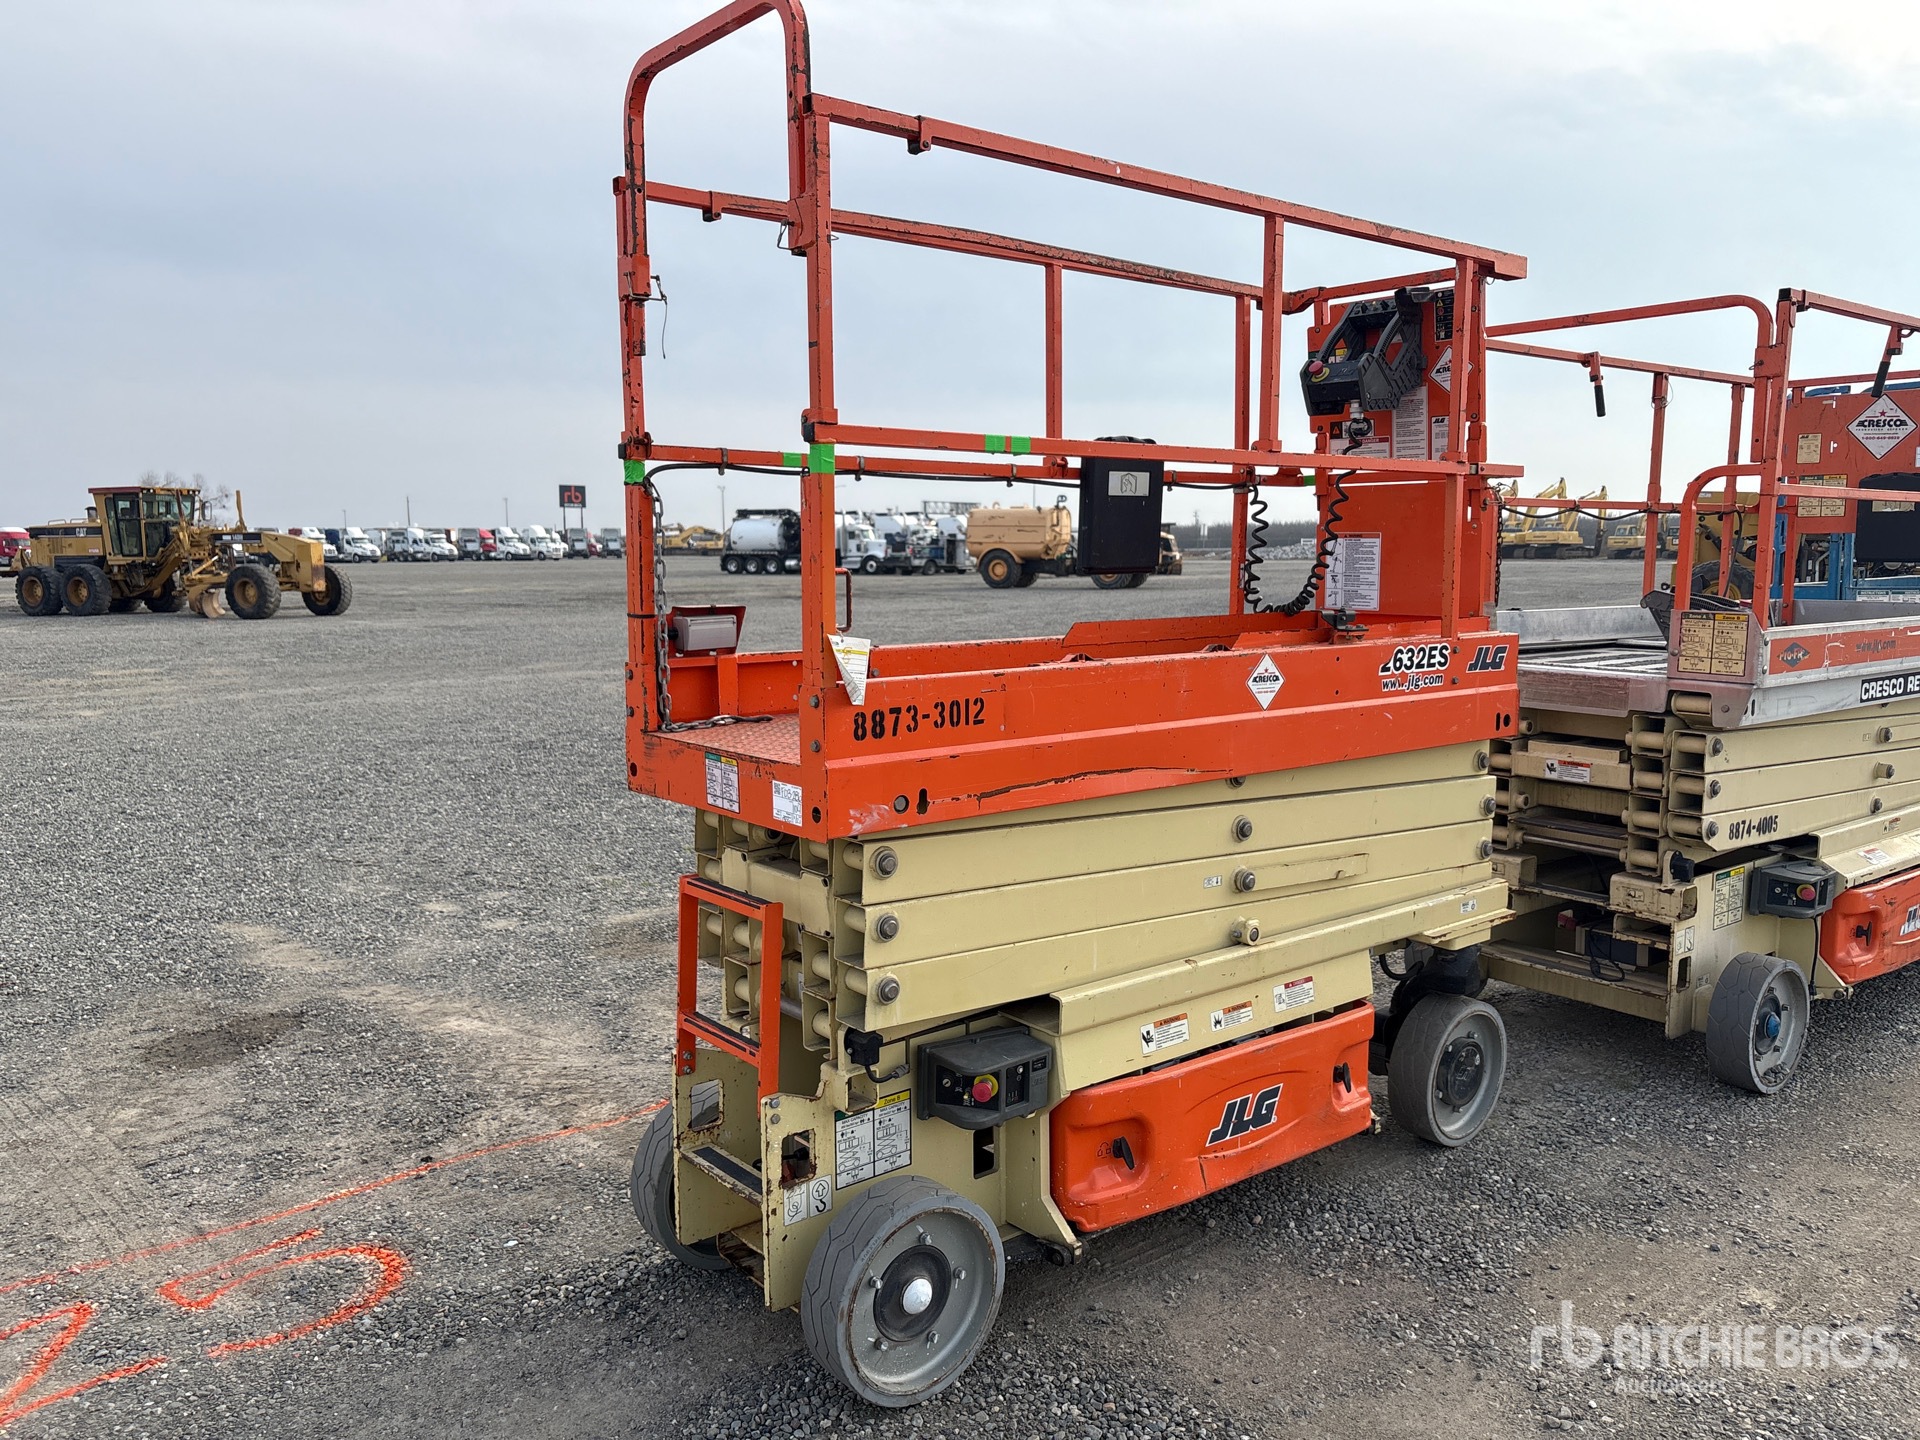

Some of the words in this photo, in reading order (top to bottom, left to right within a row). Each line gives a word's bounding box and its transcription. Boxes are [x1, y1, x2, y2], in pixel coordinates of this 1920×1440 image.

[1860, 418, 1903, 428] CRESCO
[564, 486, 582, 503] rb
[76, 527, 87, 537] CAT
[1467, 645, 1508, 672] JLG
[1253, 675, 1279, 683] CRESCO
[1862, 678, 1904, 700] CRESCO
[853, 697, 985, 741] 8873-3012
[1728, 815, 1778, 840] 8874-4005
[884, 1097, 896, 1105] Zone
[1206, 1084, 1282, 1146] JLG
